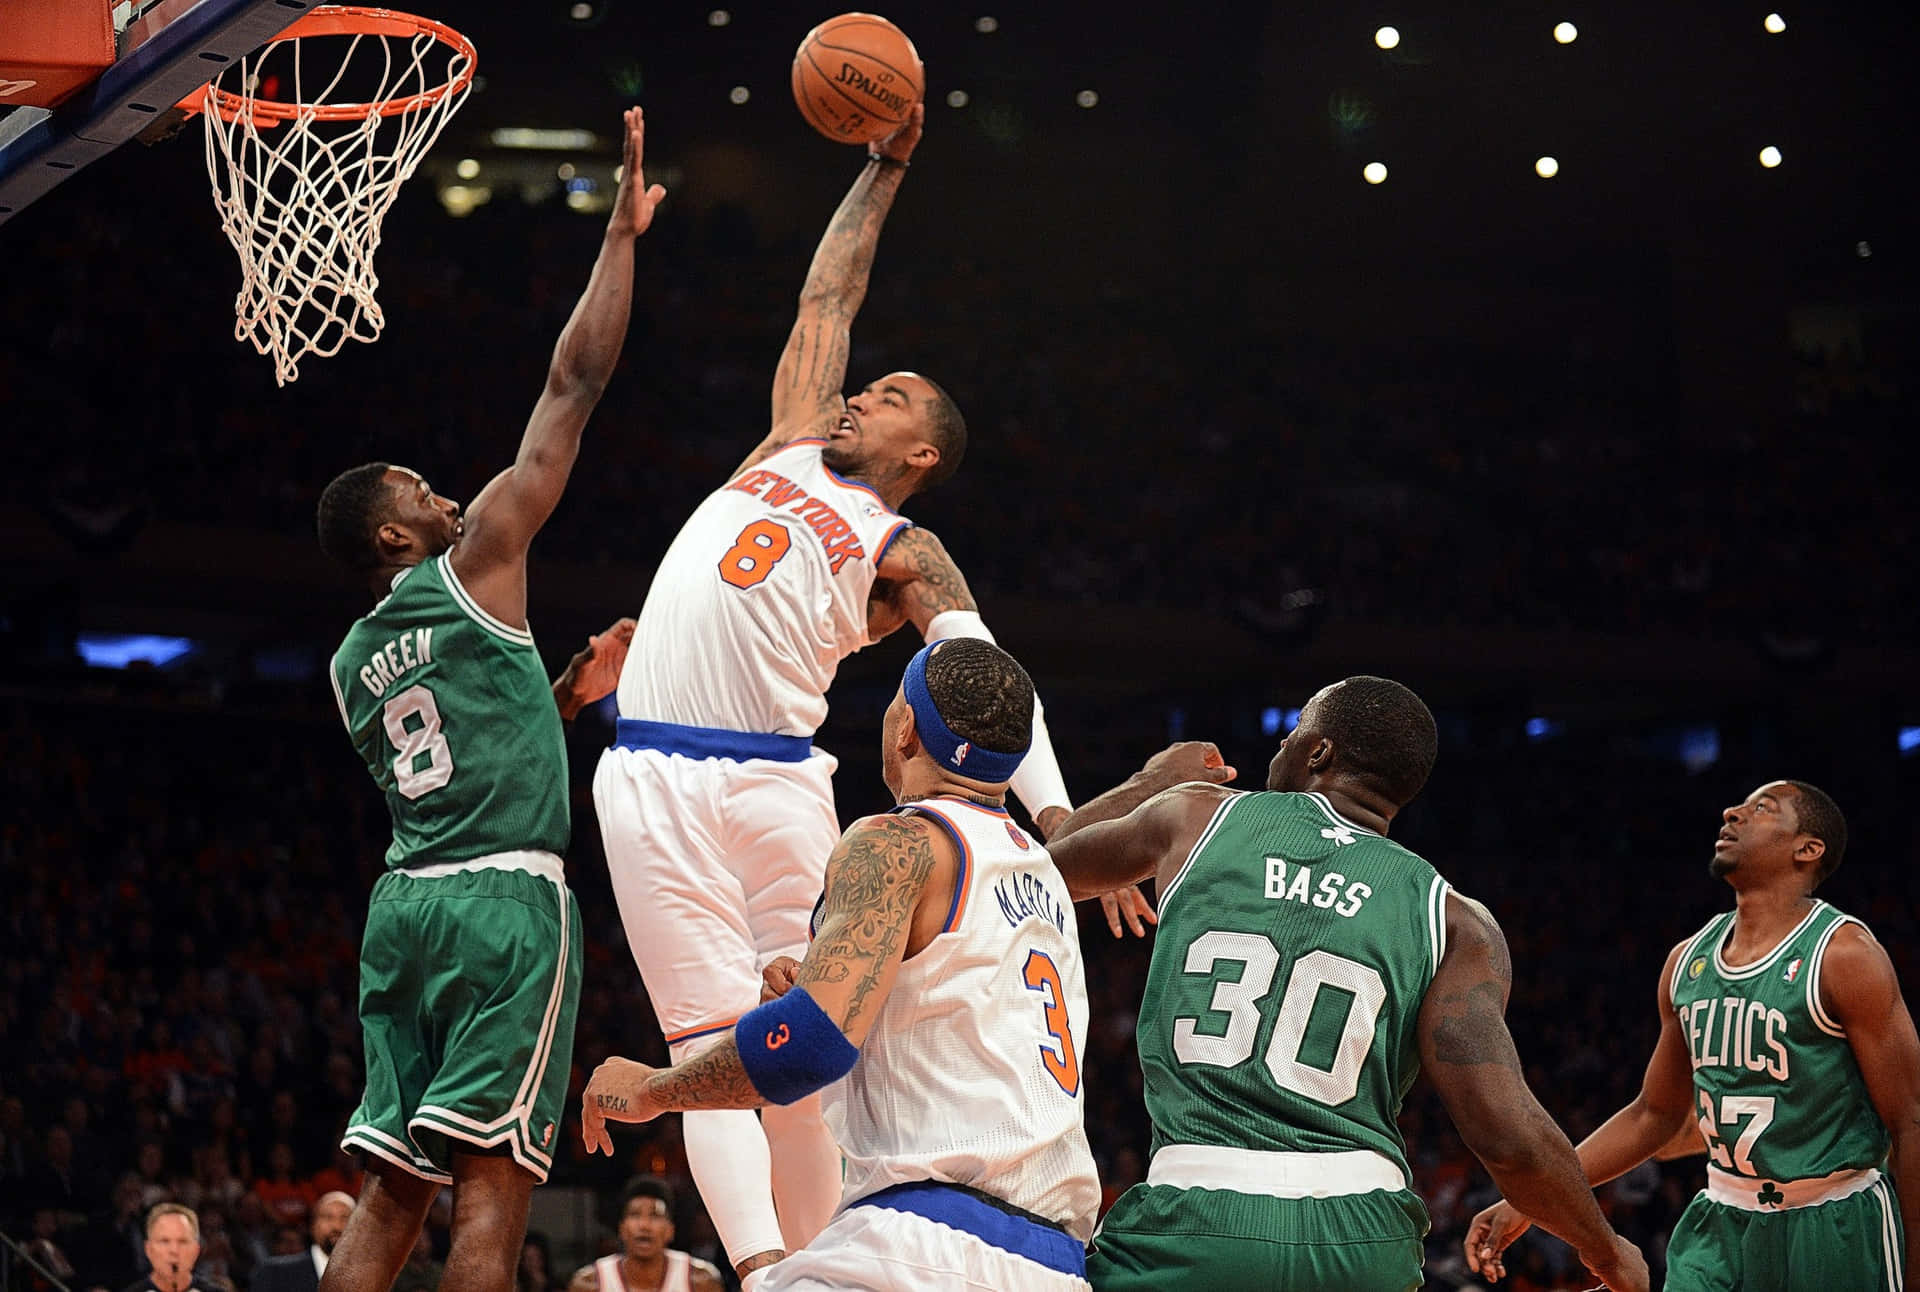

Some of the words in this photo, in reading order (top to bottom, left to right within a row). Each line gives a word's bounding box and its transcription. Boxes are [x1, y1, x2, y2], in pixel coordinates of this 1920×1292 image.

[718, 518, 792, 590] 8
[790, 497, 866, 576] YORK
[360, 627, 433, 698] GREEN
[383, 684, 454, 800] 8
[994, 871, 1065, 937] MARTIN
[1264, 857, 1372, 917] BASS
[766, 1023, 790, 1050] 3
[1022, 948, 1080, 1098] 3
[1173, 931, 1387, 1106] 30
[1698, 1088, 1775, 1176] 27
